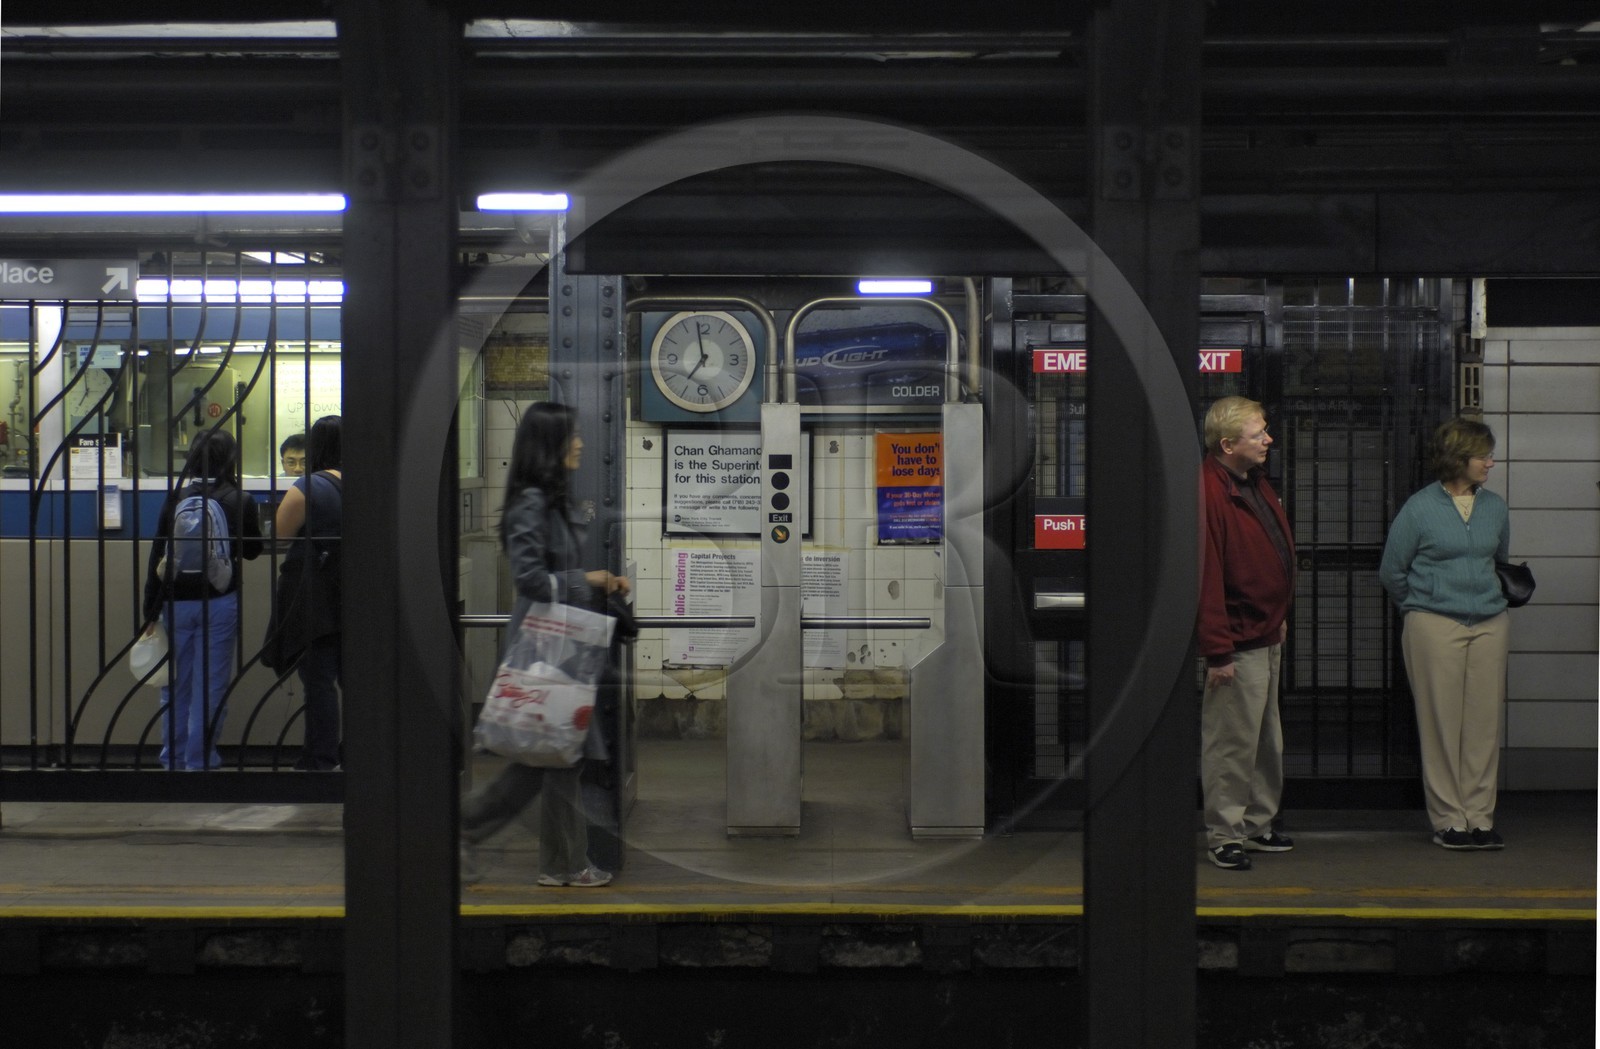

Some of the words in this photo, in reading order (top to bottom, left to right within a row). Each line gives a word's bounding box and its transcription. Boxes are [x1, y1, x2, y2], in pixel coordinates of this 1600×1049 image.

[0, 262, 54, 284] lace
[667, 353, 678, 365] 9
[729, 354, 739, 366] 3
[780, 356, 820, 368] UD
[831, 350, 888, 363] LIGHT
[697, 384, 709, 396] 6
[892, 386, 940, 398] COLDER
[79, 438, 94, 447] Fare
[891, 443, 911, 454] You
[674, 445, 704, 456] Chan
[897, 454, 922, 465] have
[926, 455, 937, 465] to
[674, 460, 684, 470] is
[689, 460, 707, 470] the
[712, 460, 761, 473] Superint
[892, 465, 914, 476] lose
[675, 473, 691, 483] for
[696, 473, 716, 483] this
[721, 474, 760, 484] station
[772, 513, 788, 522] Exit
[1043, 518, 1075, 531] Push
[675, 552, 688, 592] Hearing
